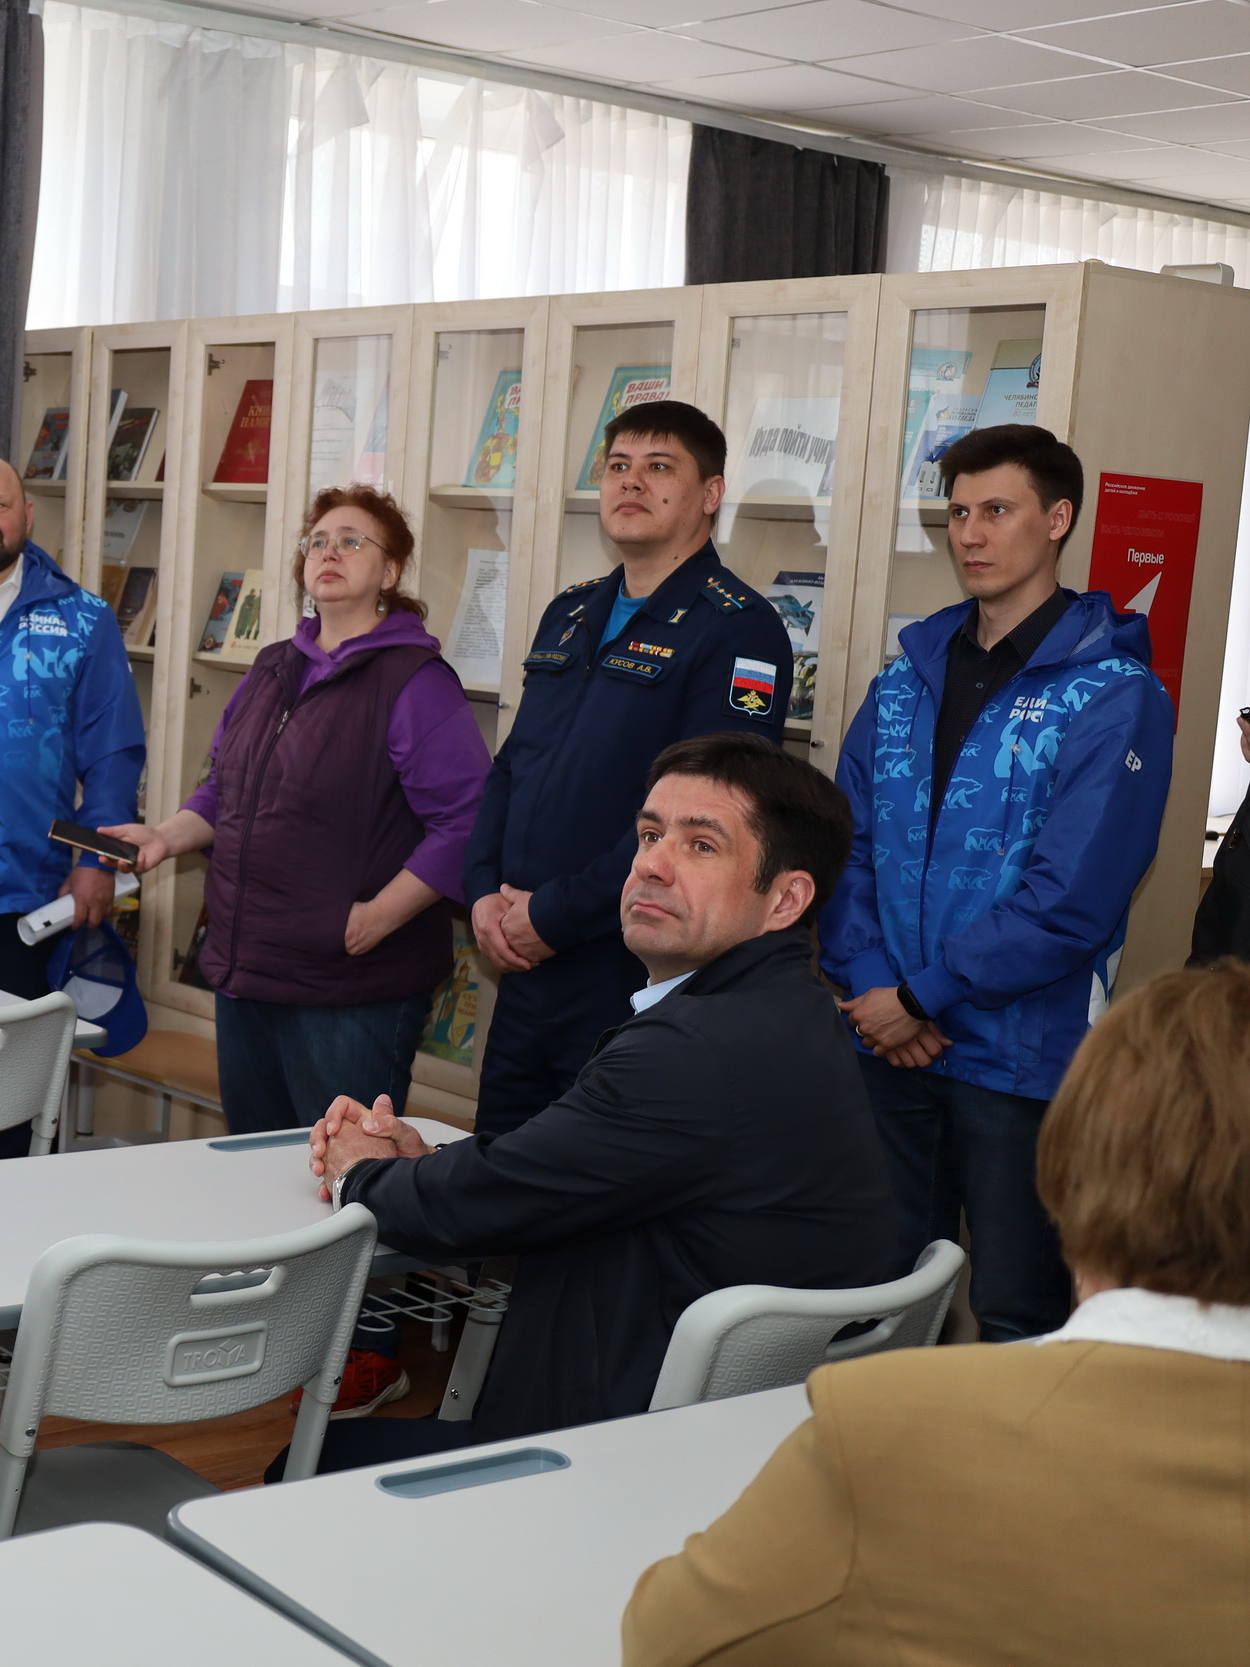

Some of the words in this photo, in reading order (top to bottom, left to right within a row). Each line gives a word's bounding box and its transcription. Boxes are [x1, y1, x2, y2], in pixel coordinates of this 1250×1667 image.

[626, 380, 665, 394] ВАШИ
[624, 391, 671, 404] ПРАВА!
[1127, 548, 1165, 568] Первые
[18, 621, 68, 638] РОССИЯ
[1124, 749, 1142, 773] ЕР
